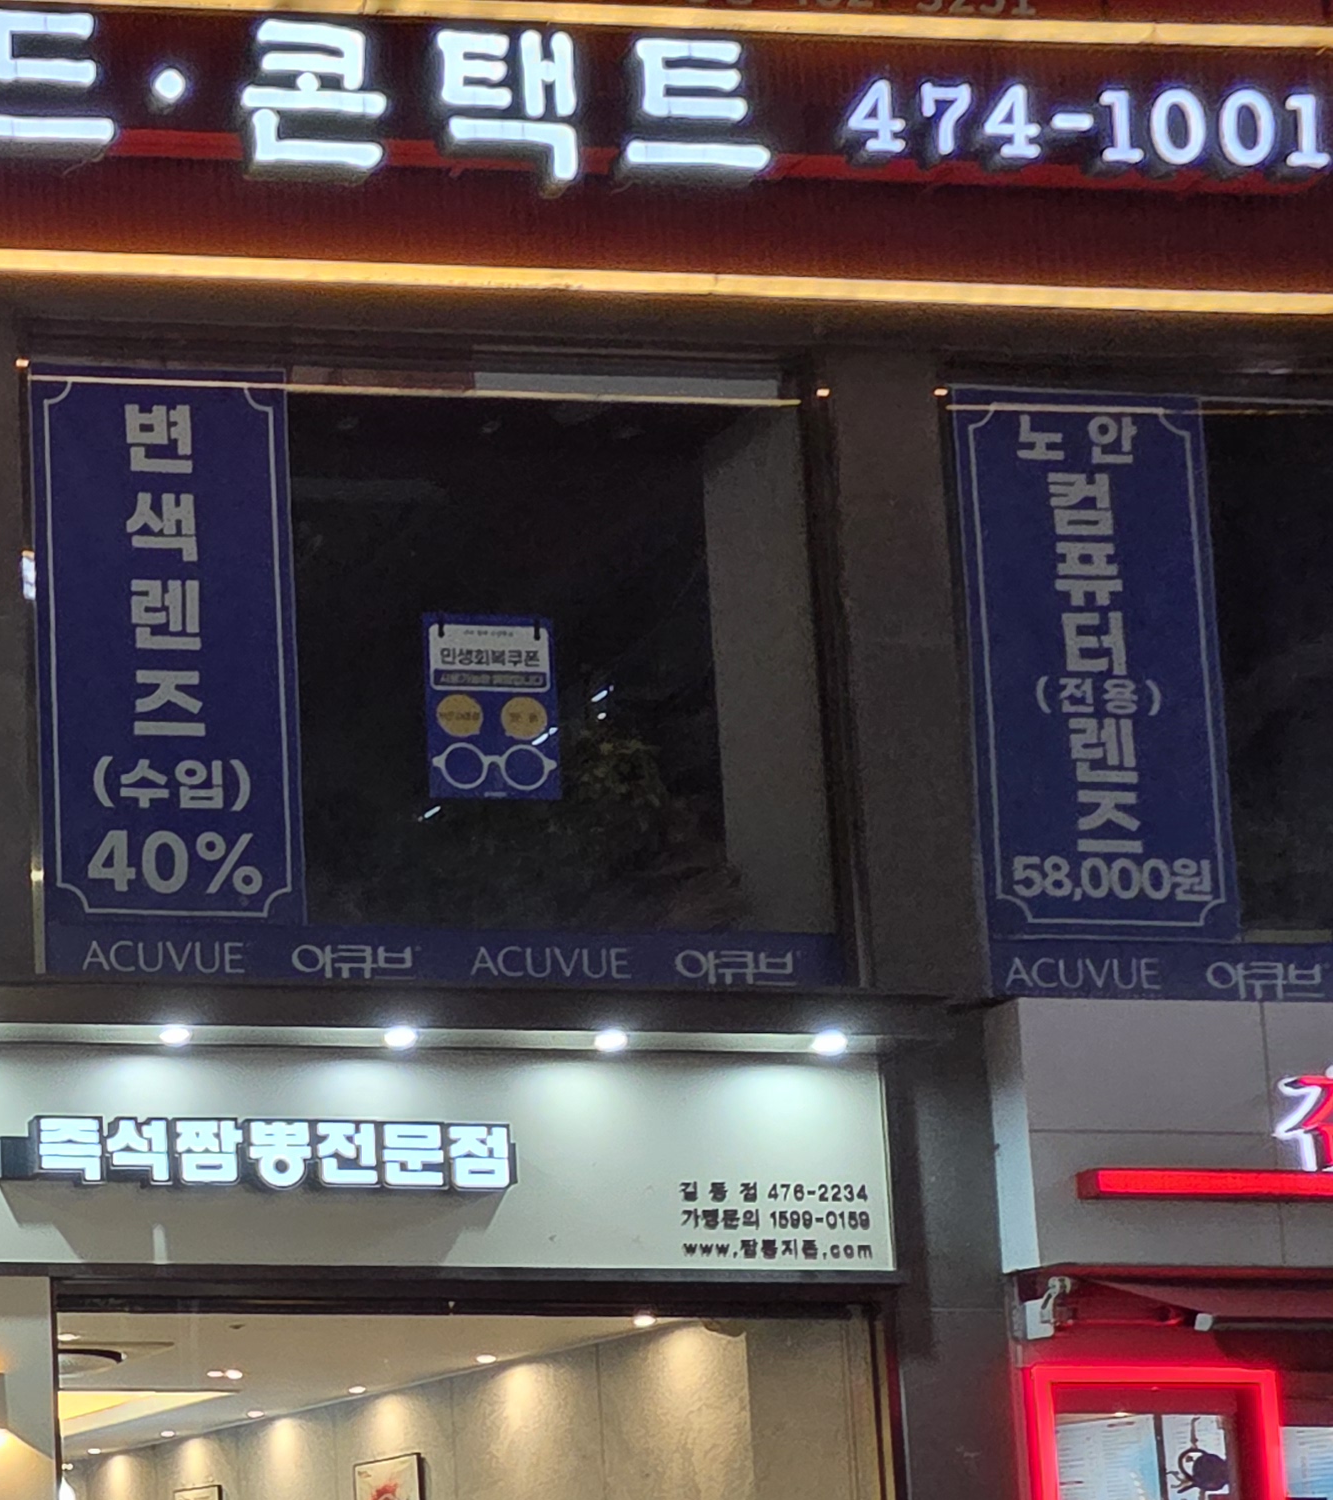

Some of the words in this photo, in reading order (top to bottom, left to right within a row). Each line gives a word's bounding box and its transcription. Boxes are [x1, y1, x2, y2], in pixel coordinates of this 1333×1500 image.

[846, 78, 1331, 168] 474-1001
[1047, 471, 1128, 677] 컴퓨터
[92, 757, 252, 812] (수입)
[86, 830, 264, 896] 40%
[1012, 855, 1214, 903] 58,000원
[82, 940, 246, 975] ACUVUE
[291, 943, 416, 980] 아큐브
[471, 946, 633, 980] ACUVUE
[674, 949, 798, 985] 아큐브
[1005, 956, 1162, 991] ACUVUE
[36, 1115, 512, 1189] 즉석짬뽕전문점
[767, 1182, 869, 1203] 476-2234
[680, 1207, 760, 1231] 가맹문의
[769, 1209, 871, 1231] 1599-0159
